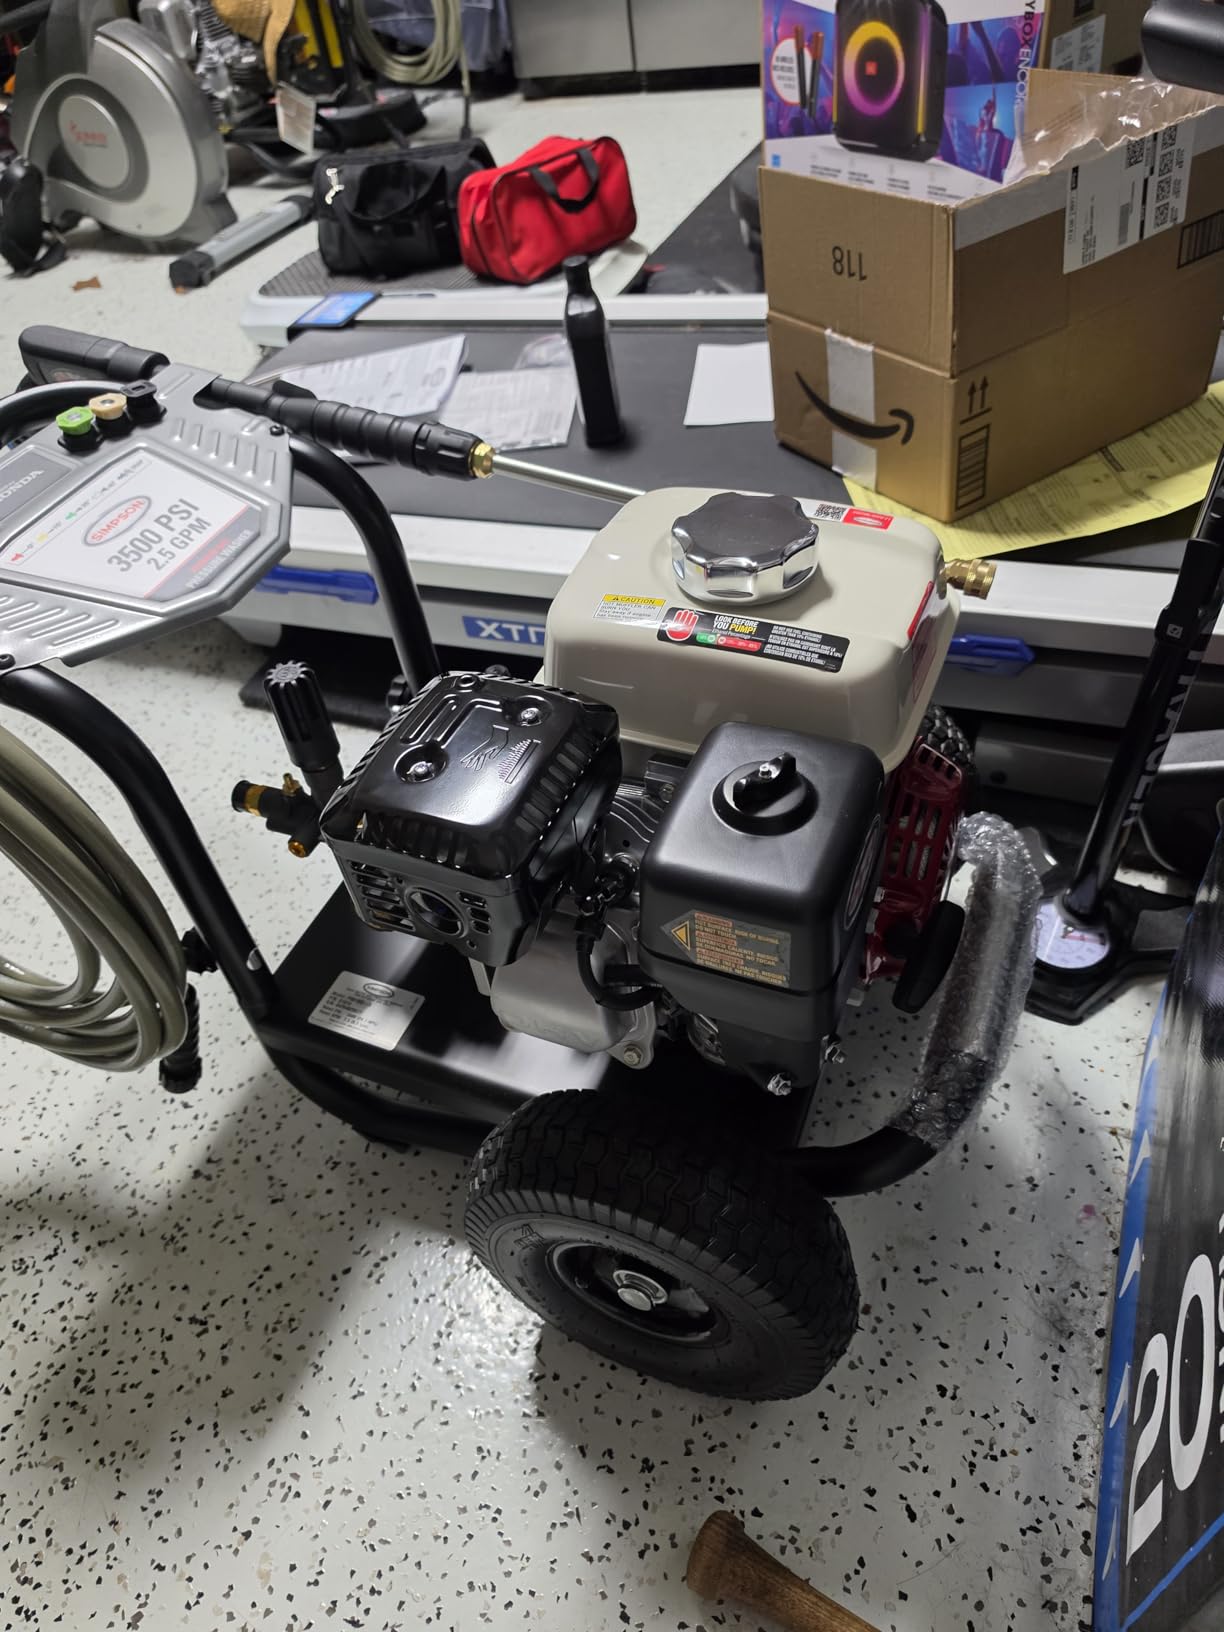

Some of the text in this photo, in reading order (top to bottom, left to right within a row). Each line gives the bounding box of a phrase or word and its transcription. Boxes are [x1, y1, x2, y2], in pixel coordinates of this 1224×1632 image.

[832, 246, 868, 282] 118
[90, 500, 145, 542] SIMPSON
[107, 528, 163, 573] 3500
[154, 498, 200, 532] PSI
[146, 546, 176, 572] 2.5
[171, 516, 212, 550] GPM
[713, 620, 757, 634] YOU PUMP!
[714, 615, 759, 627] LOOK BEFORE
[1126, 1253, 1216, 1566] 20
